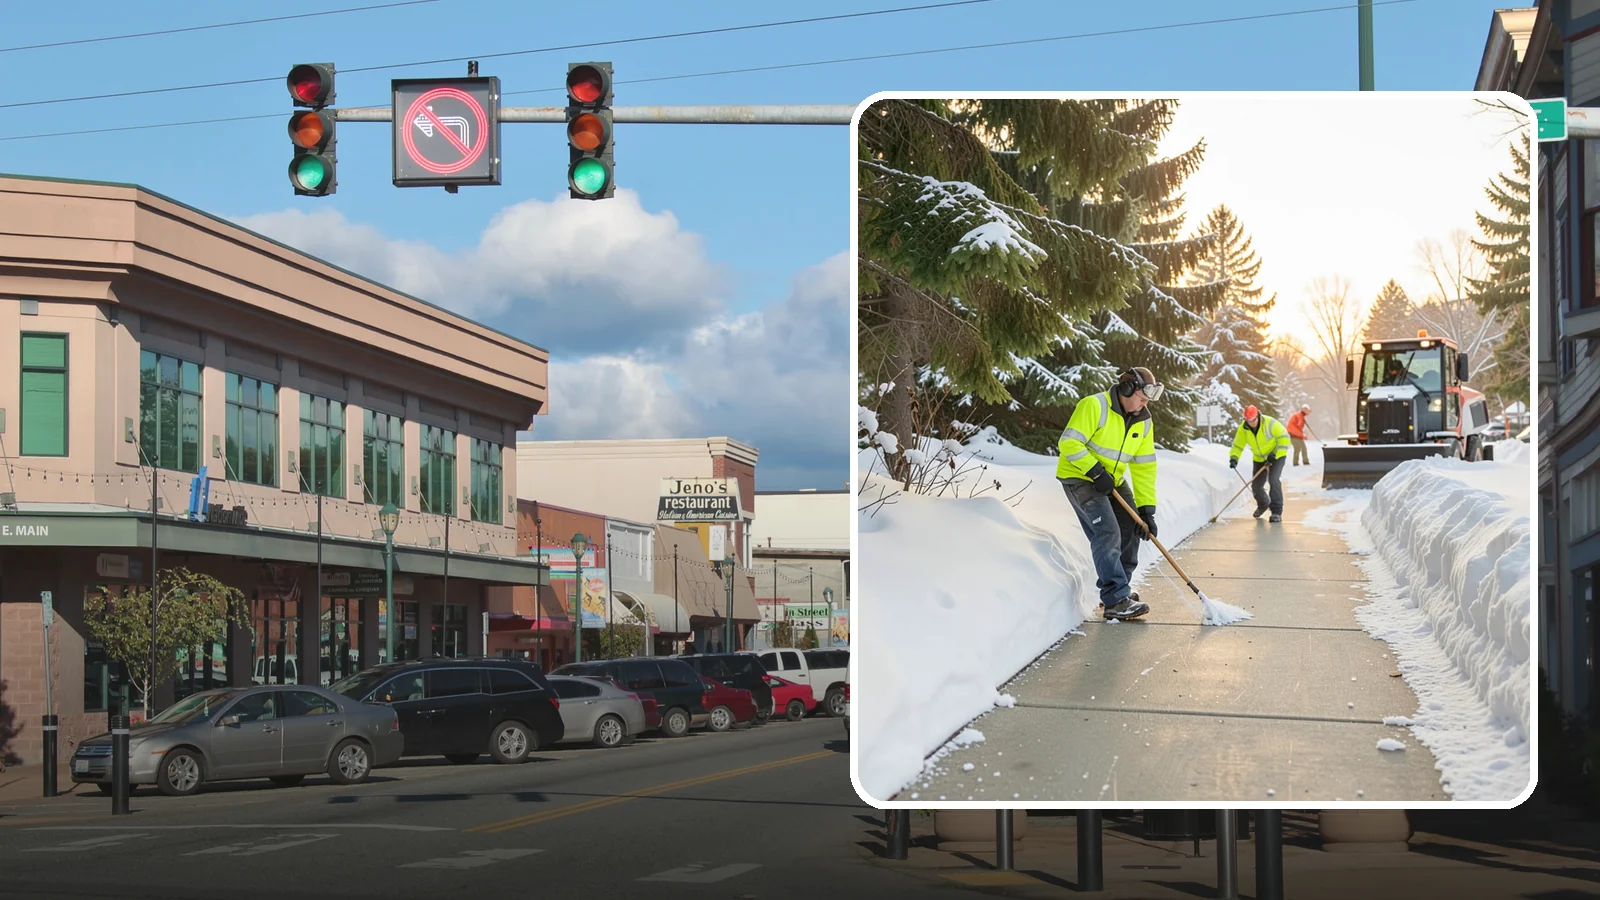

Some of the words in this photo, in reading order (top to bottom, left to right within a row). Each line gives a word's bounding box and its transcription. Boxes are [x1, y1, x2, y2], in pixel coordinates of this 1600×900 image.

[669, 480, 728, 495] Jeno's
[665, 496, 731, 509] restaurant
[685, 510, 714, 520] American
[714, 509, 738, 519] Cuisine
[2, 525, 13, 536] E.
[15, 525, 49, 537] MAIN
[797, 607, 828, 617] Street
